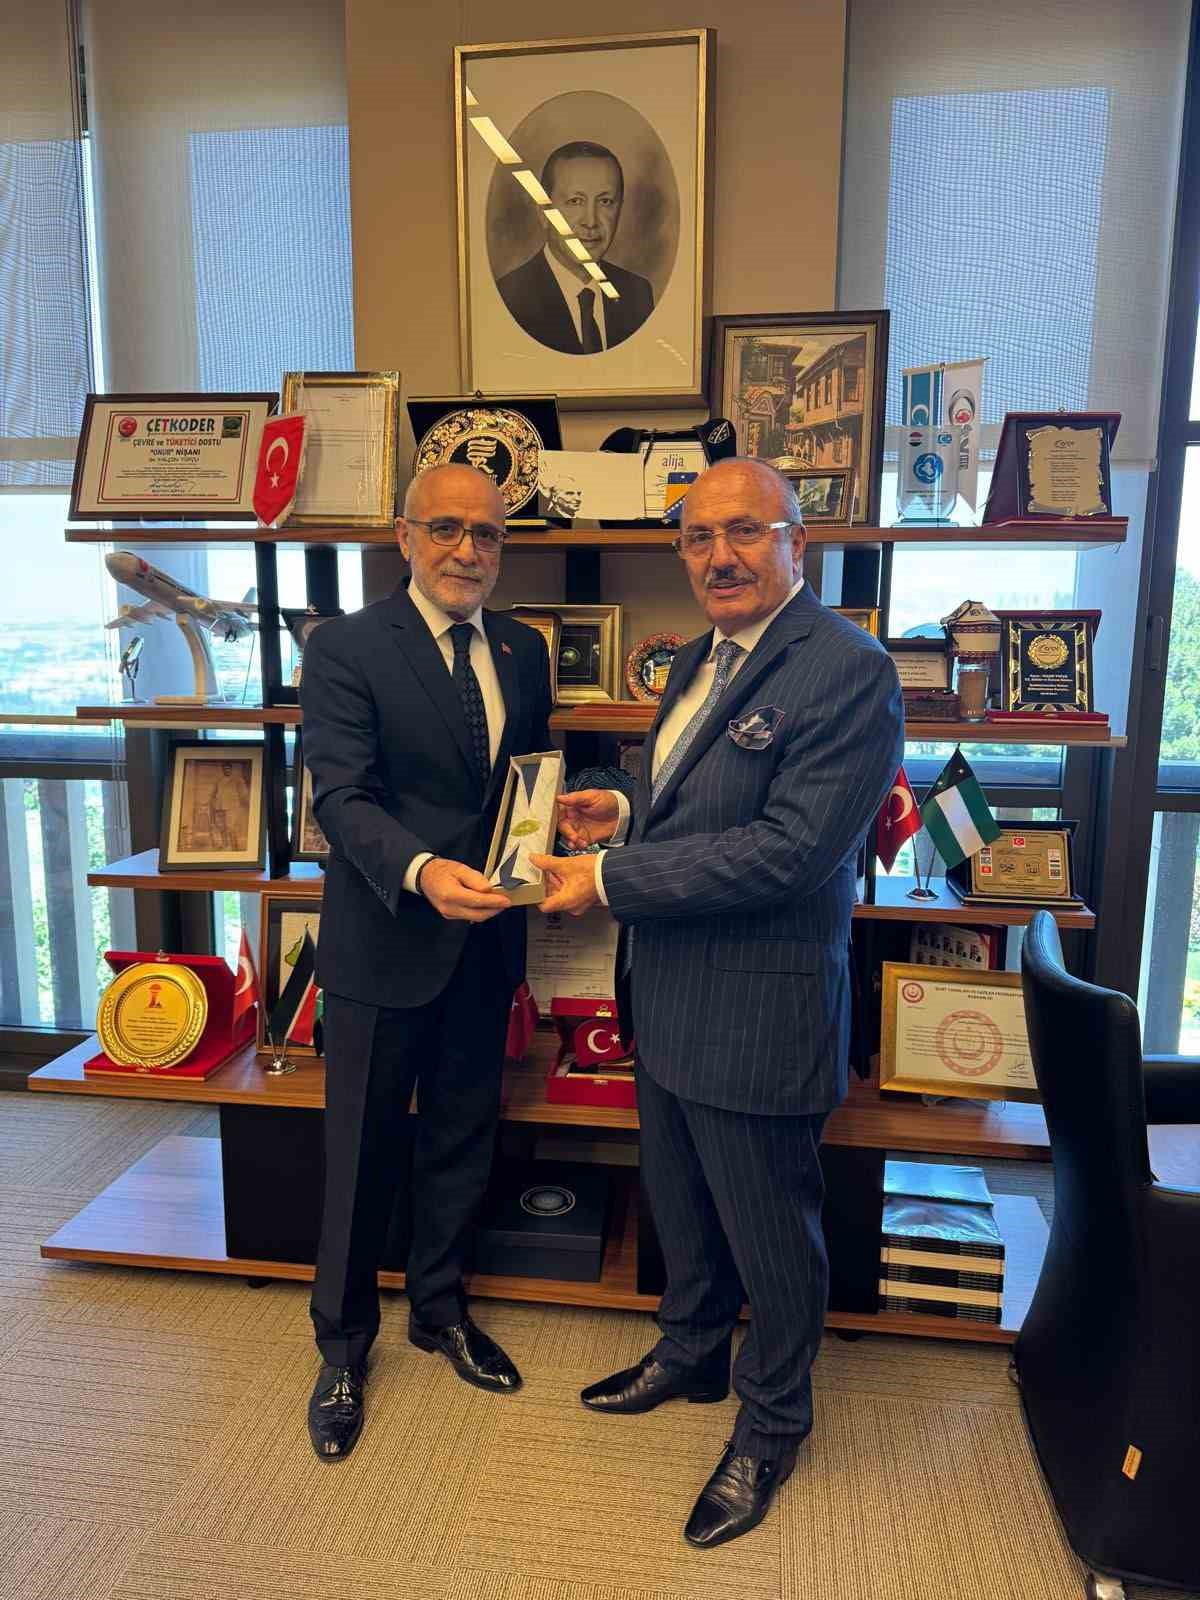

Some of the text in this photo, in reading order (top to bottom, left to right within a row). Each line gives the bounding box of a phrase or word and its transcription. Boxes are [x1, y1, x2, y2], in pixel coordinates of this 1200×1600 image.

[146, 418, 215, 437] ÇETKODER
[132, 438, 155, 448] ÇEVRE
[198, 438, 222, 446] DOSTU
[662, 453, 684, 471] alija
